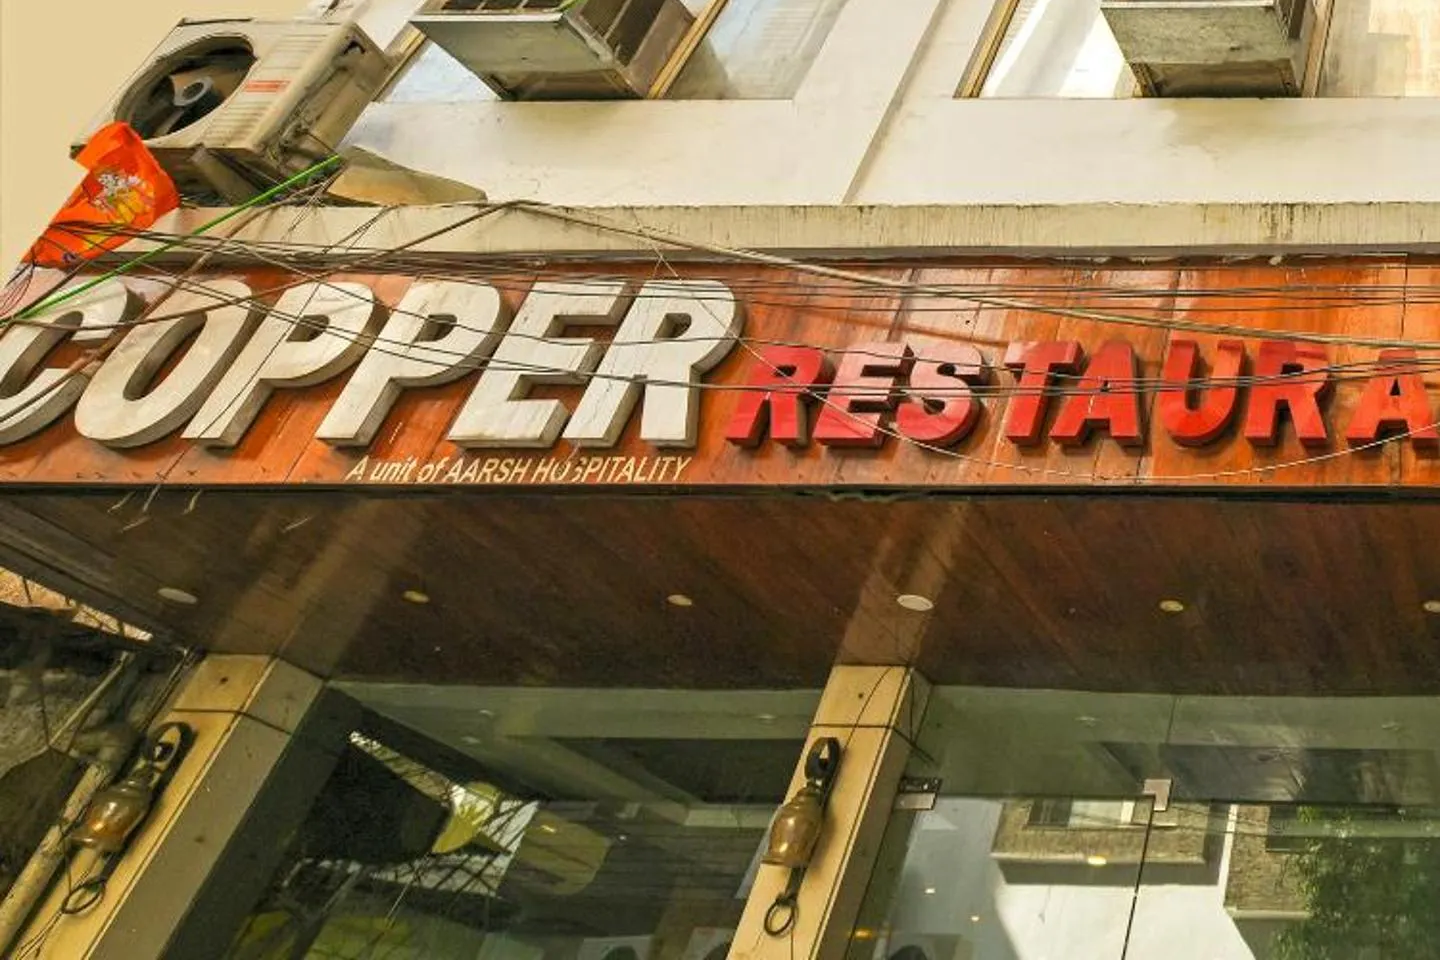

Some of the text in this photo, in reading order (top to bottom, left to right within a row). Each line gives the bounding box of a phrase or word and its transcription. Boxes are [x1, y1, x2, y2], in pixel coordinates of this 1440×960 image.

[0, 275, 746, 449] COPPER
[345, 455, 692, 483] A unit of AARSH HOSPITALITY
